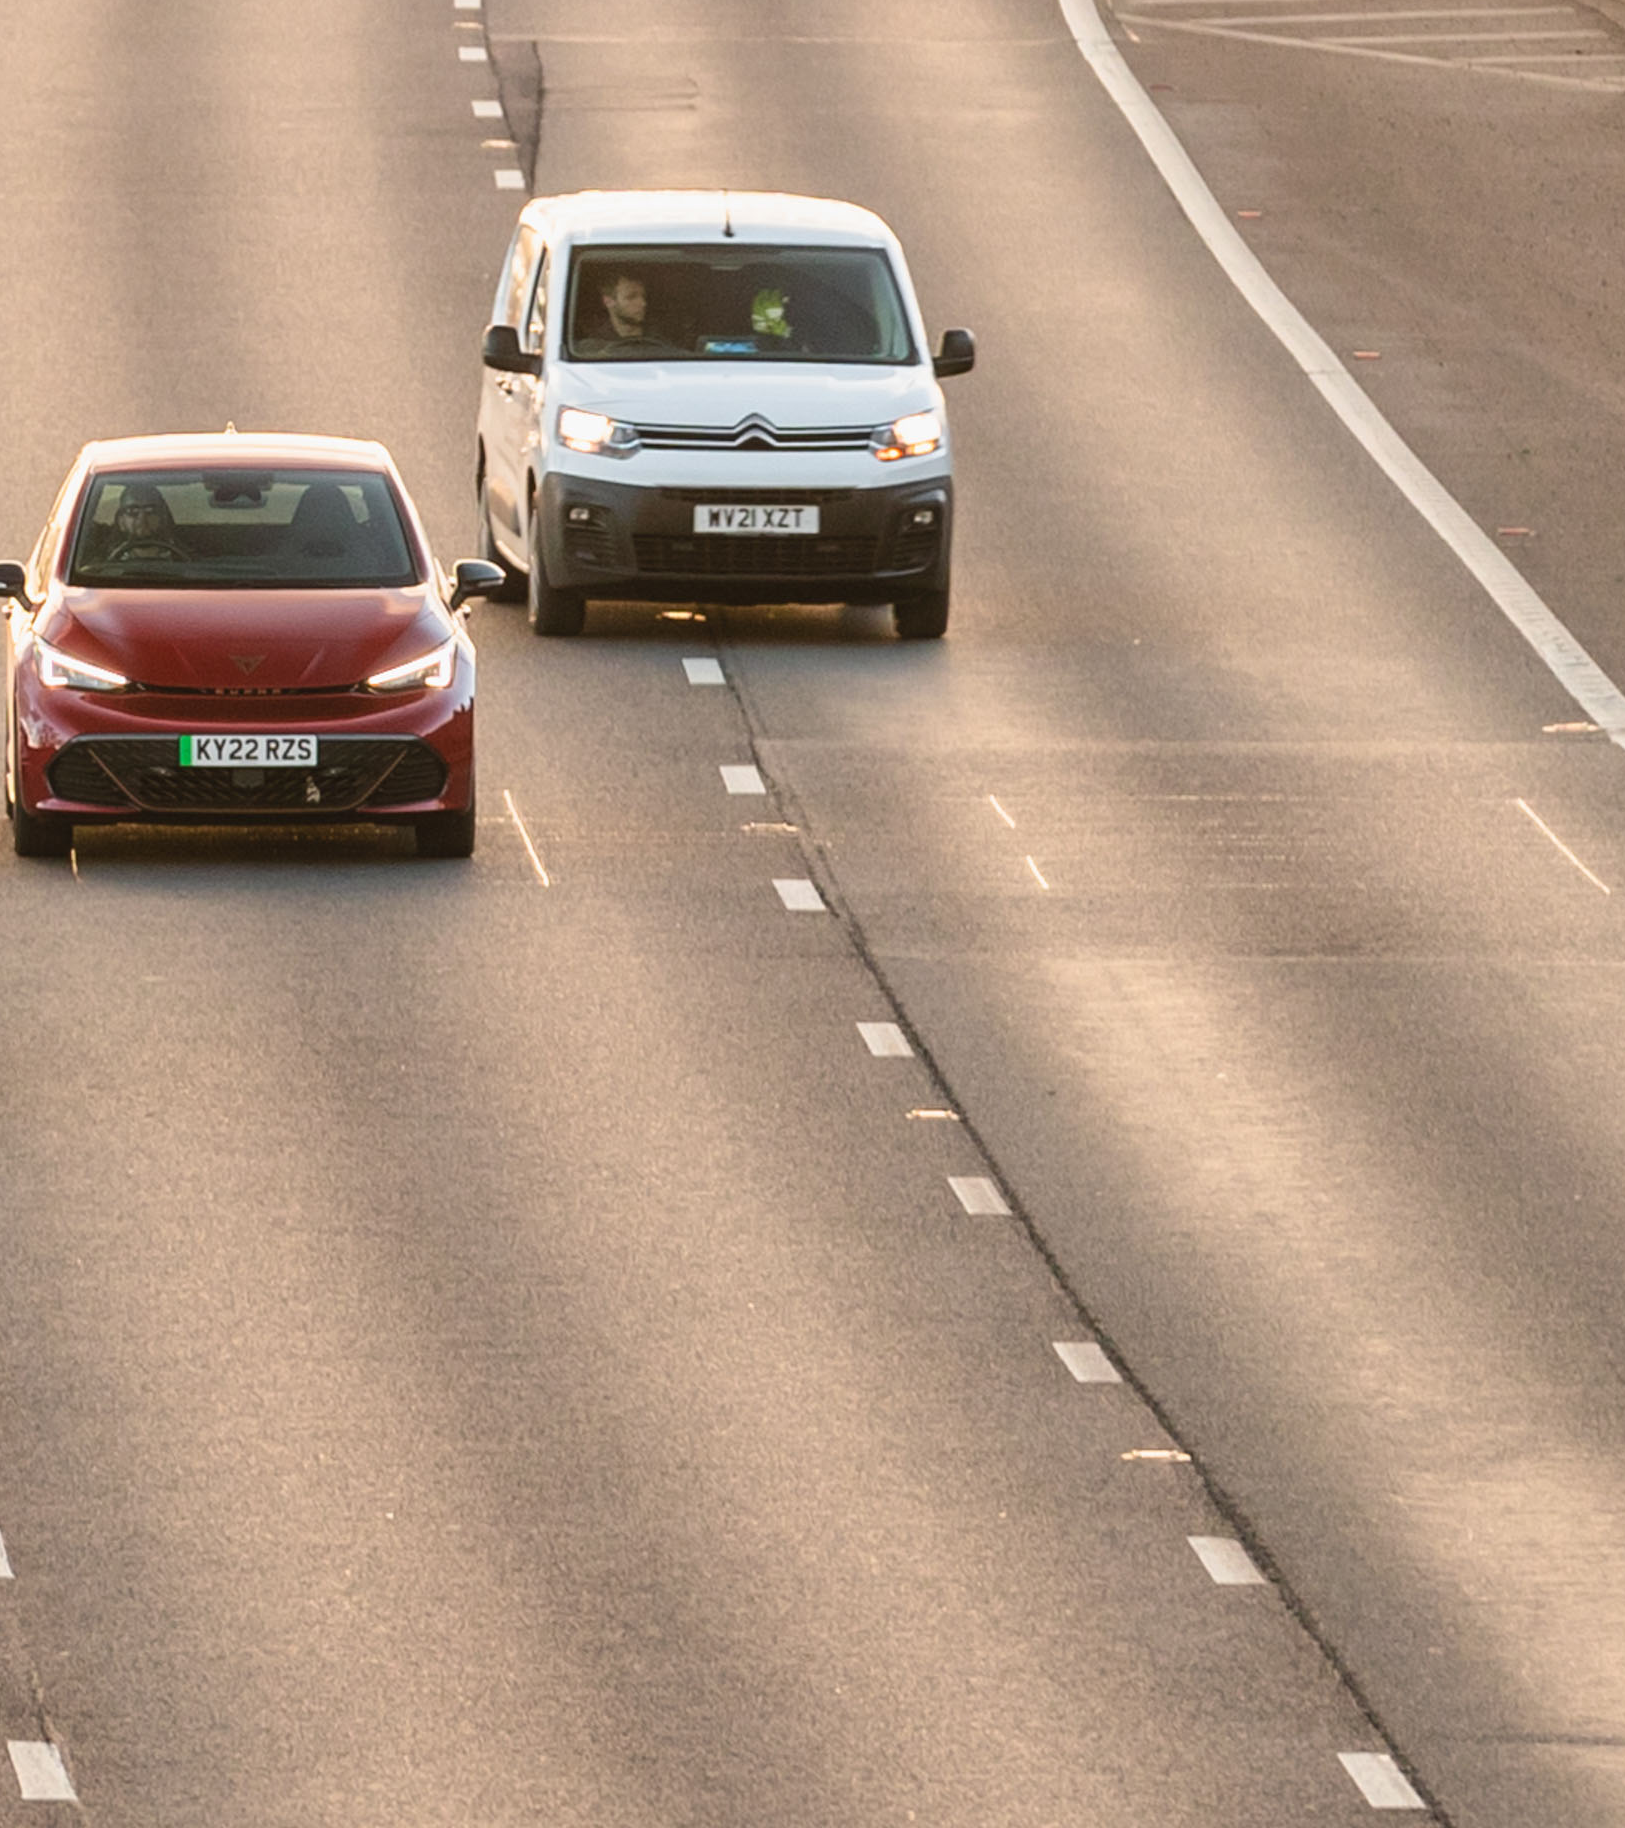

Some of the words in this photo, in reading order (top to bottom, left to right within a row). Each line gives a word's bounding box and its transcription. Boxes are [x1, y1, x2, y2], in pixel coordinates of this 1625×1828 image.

[762, 507, 805, 528] XZT
[196, 739, 261, 761] KY22
[266, 739, 312, 761] RZS
